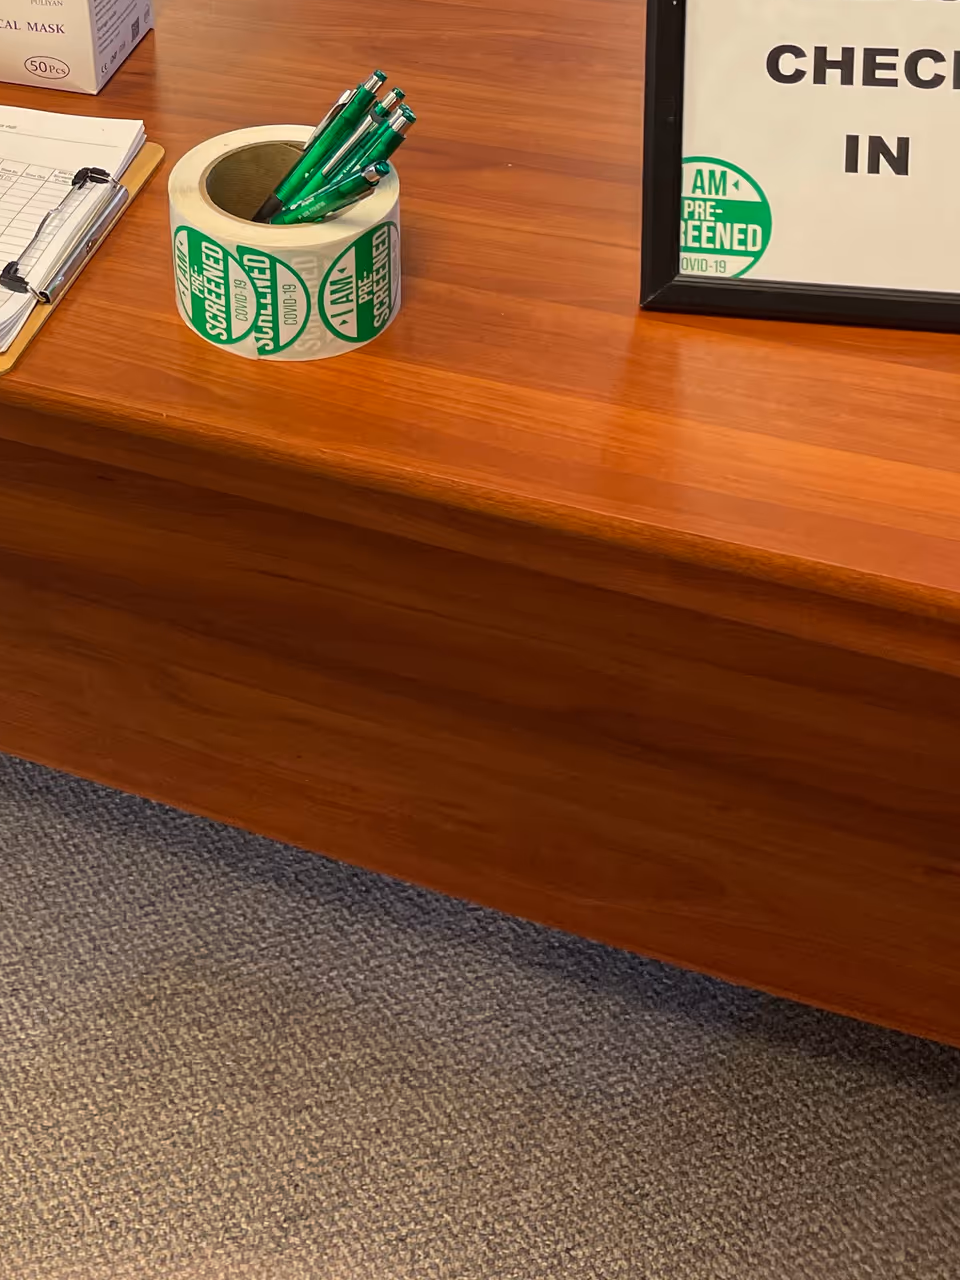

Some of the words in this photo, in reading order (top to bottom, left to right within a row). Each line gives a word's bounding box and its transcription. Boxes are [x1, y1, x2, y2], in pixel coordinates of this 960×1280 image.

[30, 0, 64, 7] PULIYAN
[27, 21, 65, 34] MASK
[766, 44, 960, 90] CHEC
[845, 134, 910, 176] IN
[691, 169, 727, 196] AM
[683, 200, 723, 221] PRE-
[191, 265, 204, 299] PRE-
[372, 225, 390, 328] SCREENED
[680, 257, 727, 273] OVID-19
[201, 241, 228, 341] SCREENED
[233, 279, 249, 321] COVID-19
[282, 283, 298, 326] COVID-19
[329, 274, 354, 306] AM
[358, 271, 373, 305] PRE-
